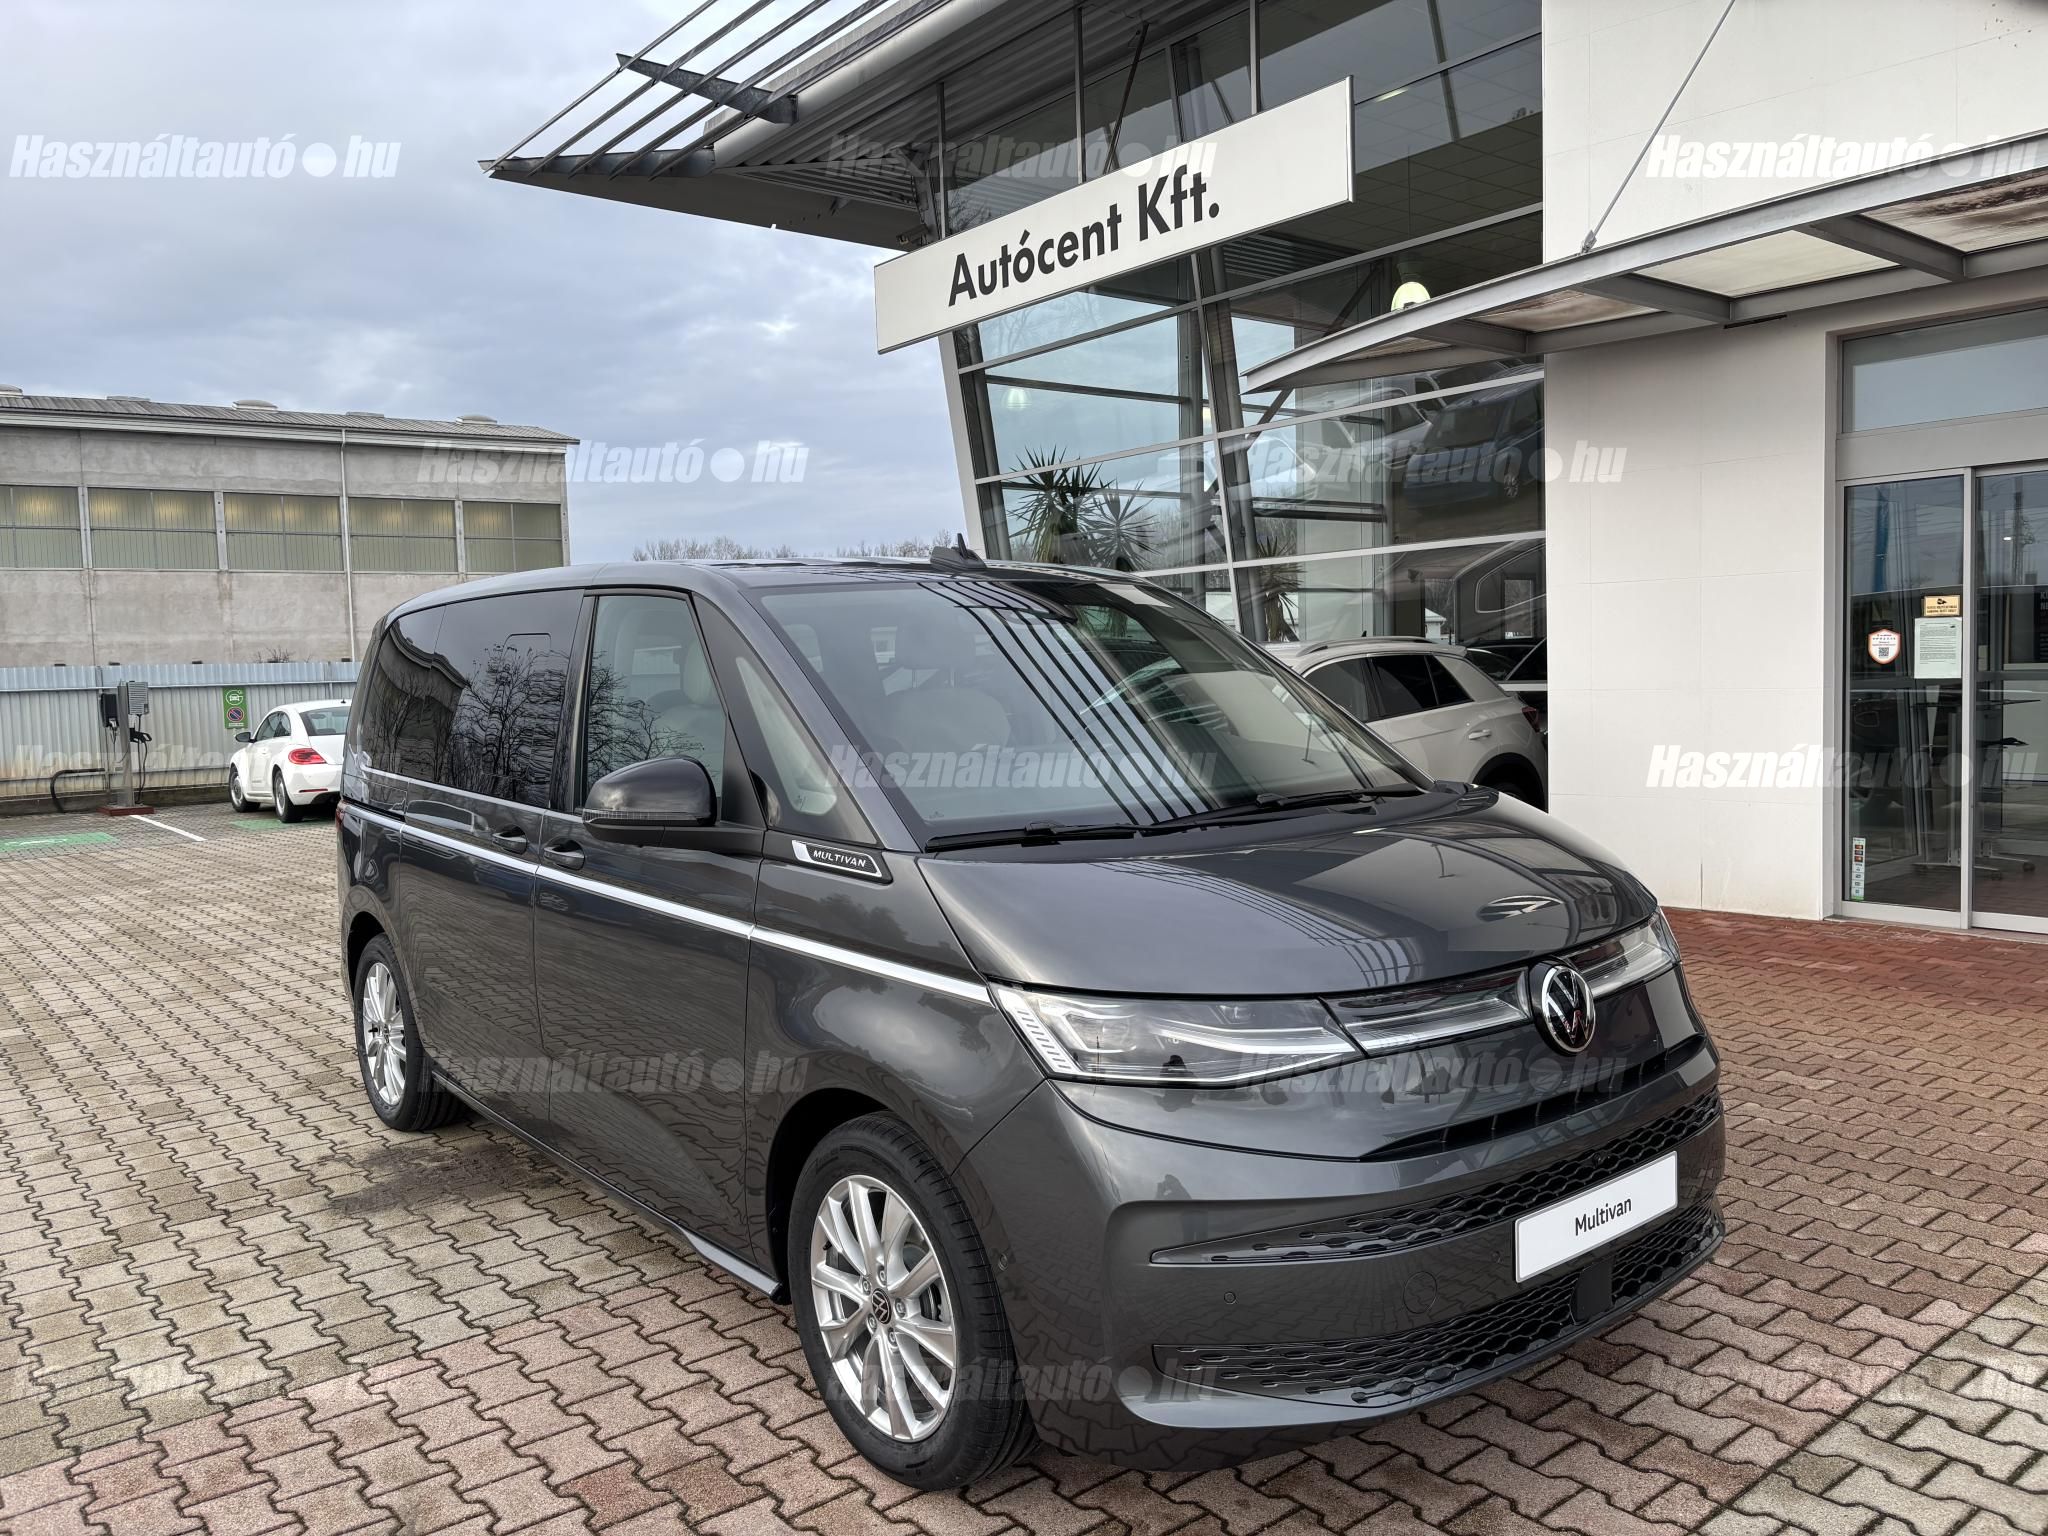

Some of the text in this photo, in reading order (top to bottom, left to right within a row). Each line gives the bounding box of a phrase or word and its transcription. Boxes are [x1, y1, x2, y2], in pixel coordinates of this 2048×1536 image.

[949, 164, 1220, 306] Autócent Kft.
[813, 850, 866, 867] MULTIVAN
[1575, 1198, 1632, 1236] Multivan
